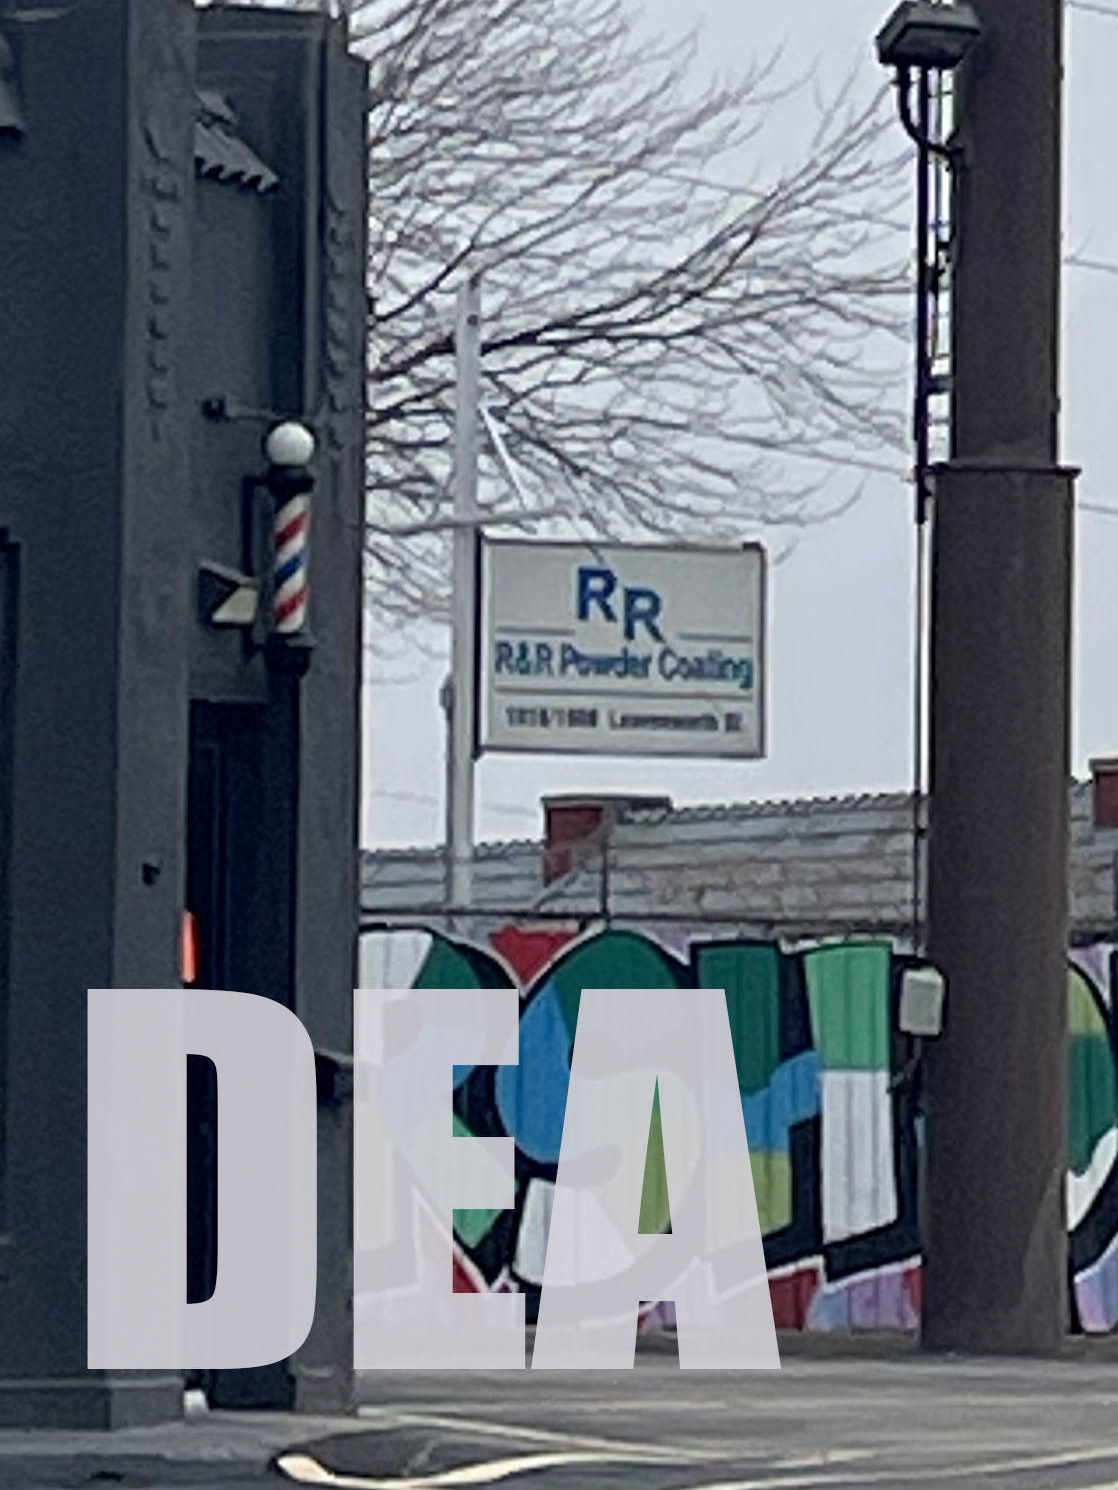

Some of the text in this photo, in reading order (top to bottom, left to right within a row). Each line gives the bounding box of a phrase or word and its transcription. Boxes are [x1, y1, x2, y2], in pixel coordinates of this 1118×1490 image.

[494, 640, 755, 691] R&R Powder Coating
